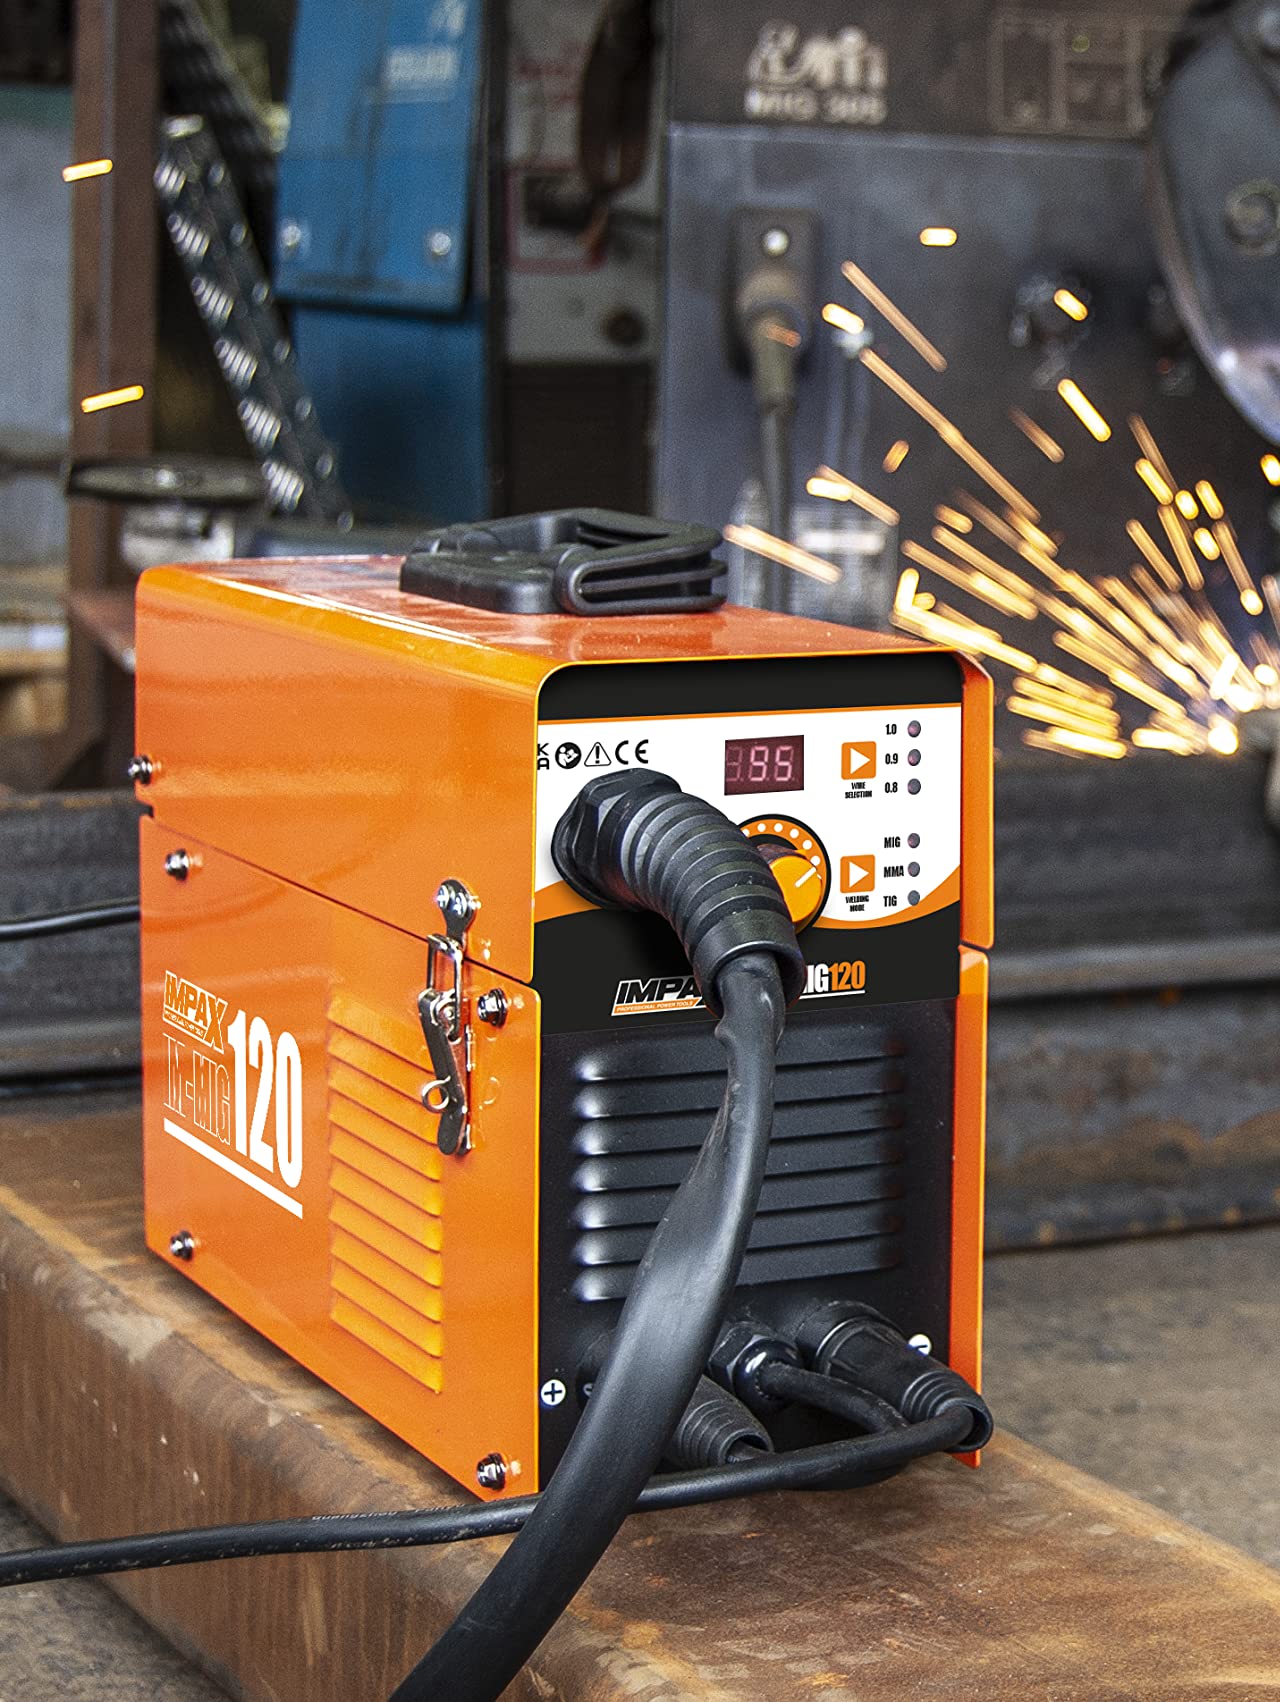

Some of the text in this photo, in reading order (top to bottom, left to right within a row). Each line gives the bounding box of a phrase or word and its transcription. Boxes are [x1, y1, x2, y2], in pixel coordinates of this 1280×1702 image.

[885, 723, 897, 735] 1.0
[615, 739, 648, 765] CE
[885, 753, 898, 765] 0.9
[851, 781, 866, 790] WIRE
[884, 782, 898, 793] 0.8
[845, 790, 872, 799] SELECTION
[884, 836, 901, 848] MIG
[883, 865, 904, 878] MMA
[845, 895, 869, 903] WELDING
[883, 895, 897, 907] TIG
[849, 904, 865, 912] MODE
[803, 960, 866, 993] IG120
[614, 976, 706, 1007] IMPA
[163, 970, 228, 1054] IMPAX
[616, 1003, 655, 1013] PROFESSIONAL
[657, 1001, 676, 1009] POWER
